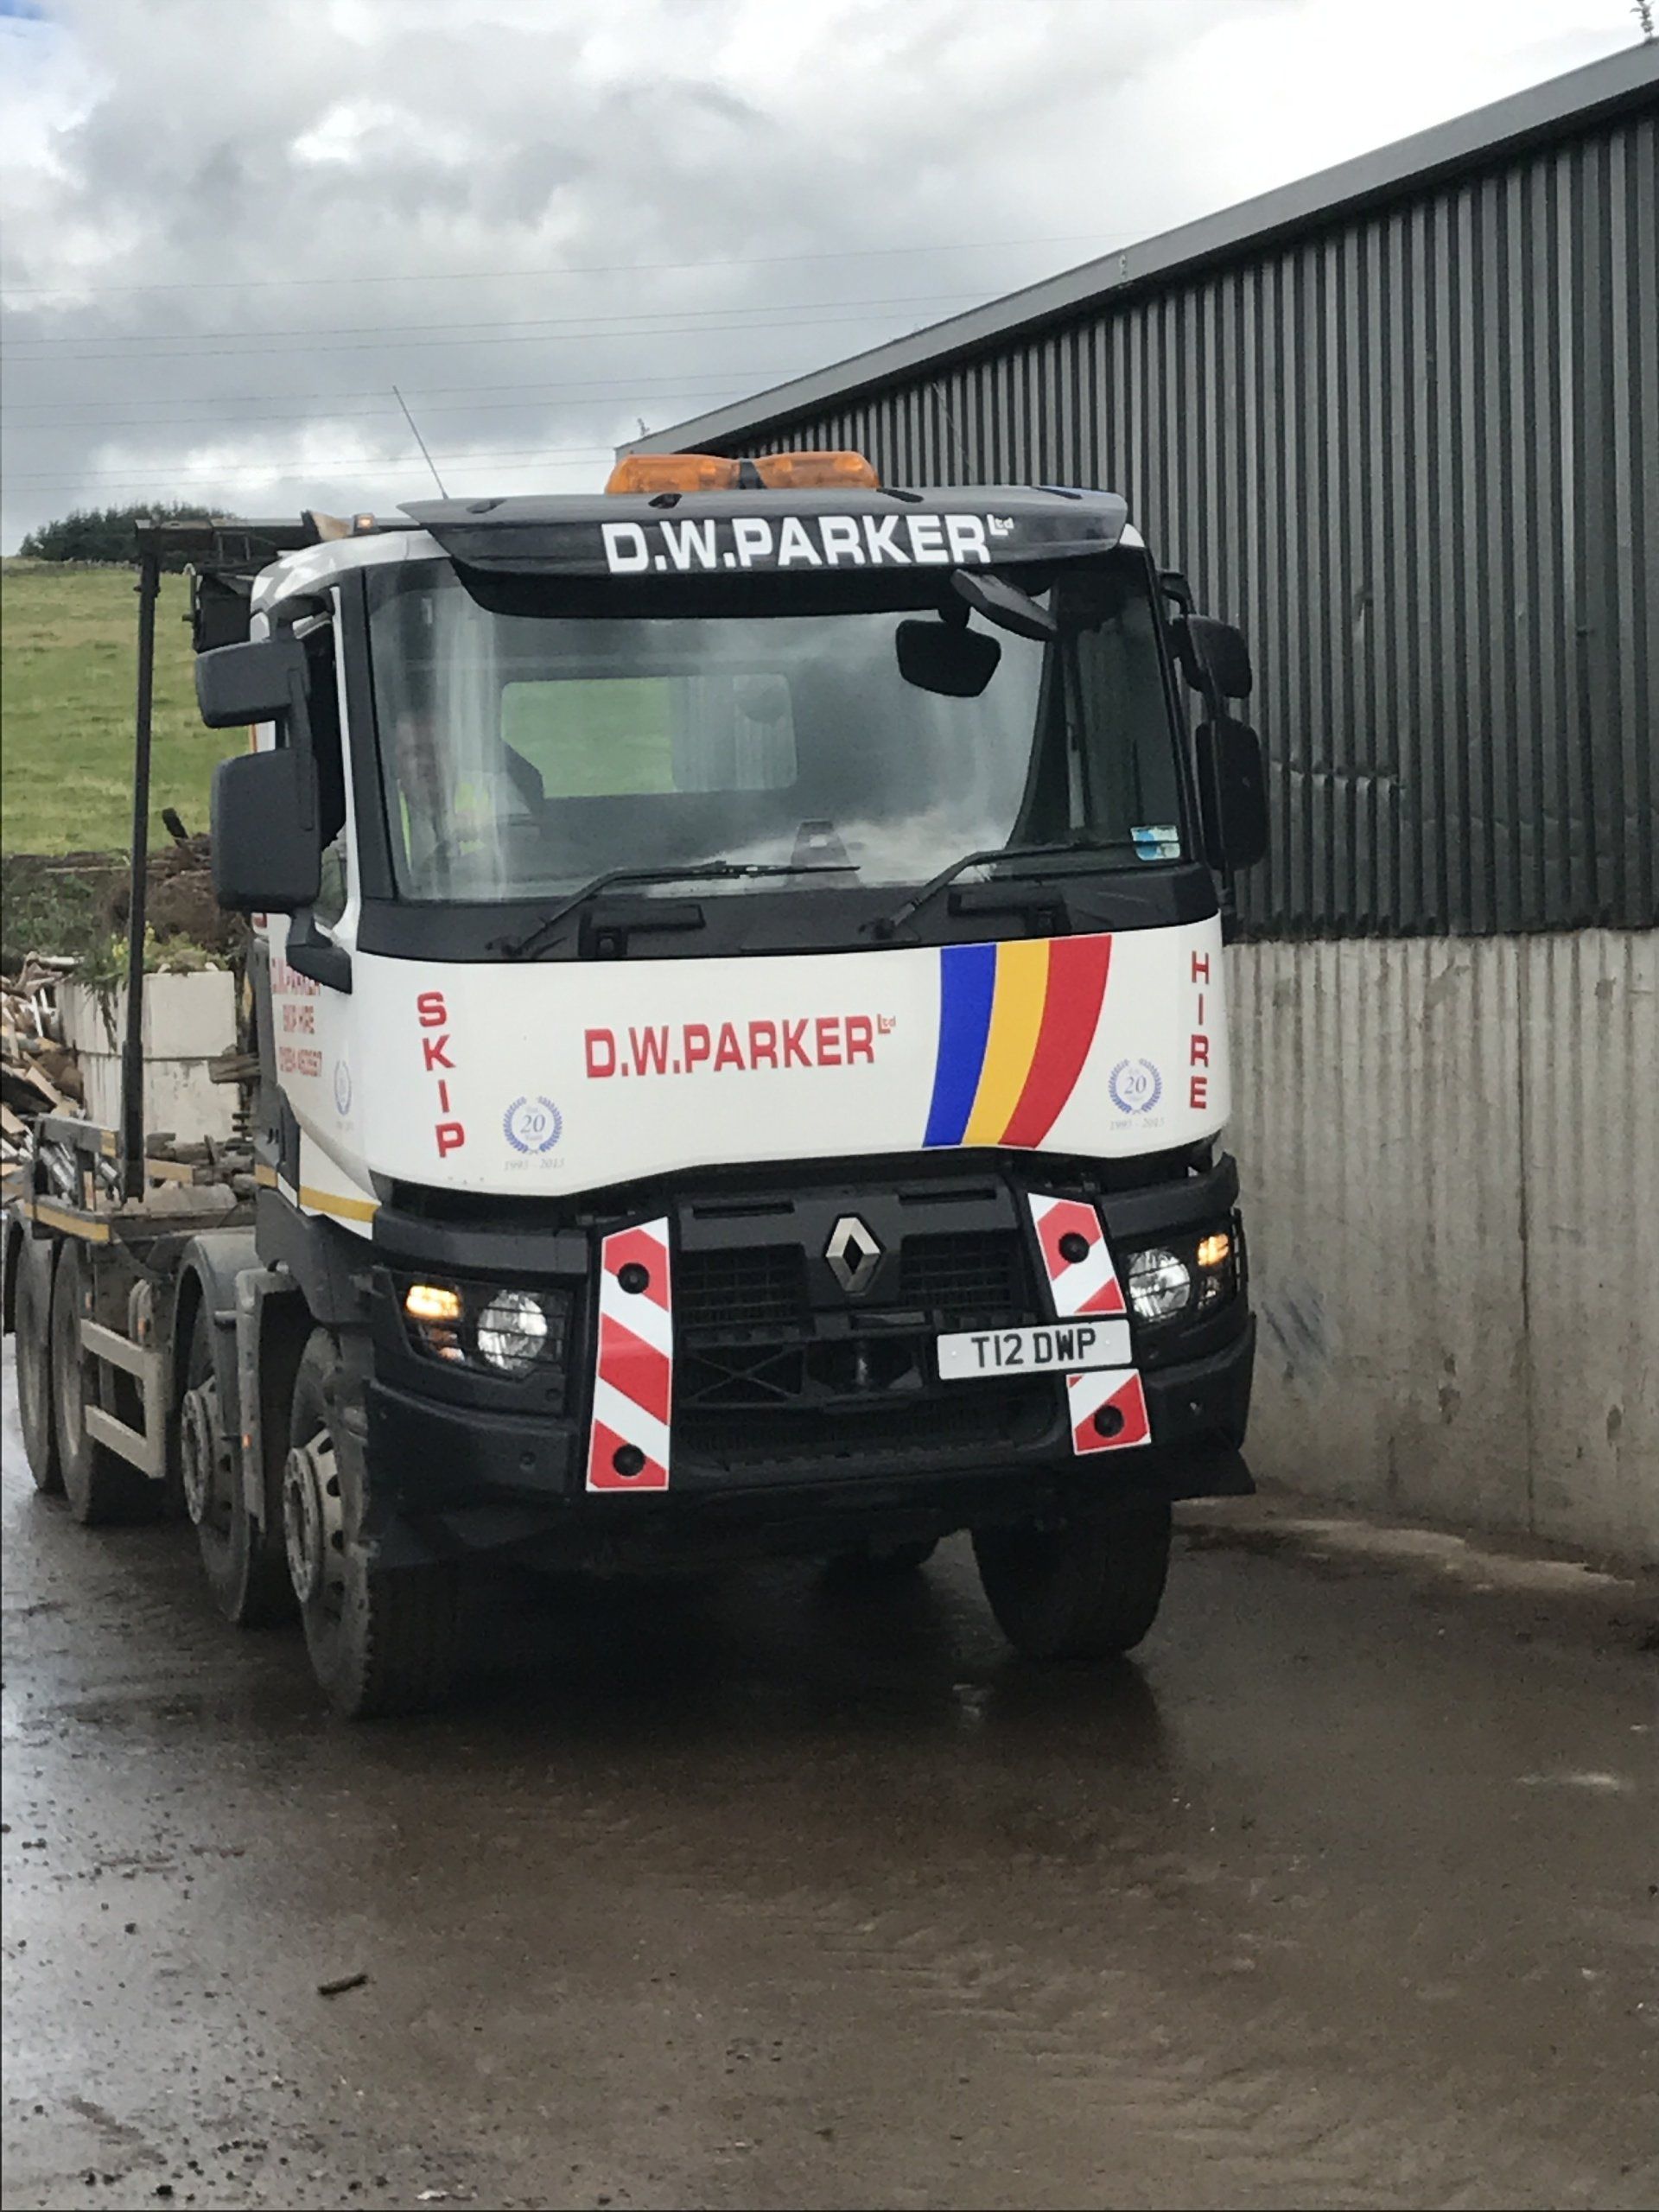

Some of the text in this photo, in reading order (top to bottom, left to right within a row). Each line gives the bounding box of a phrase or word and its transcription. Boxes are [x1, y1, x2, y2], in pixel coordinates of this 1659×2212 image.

[601, 513, 1014, 574] D.W.PARKER Ltd
[584, 1014, 874, 1078] D.W.PARKER
[1190, 950, 1210, 1109] HIRE
[416, 991, 465, 1158] SKIP
[1124, 1075, 1147, 1095] 20
[519, 1114, 546, 1134] 20
[971, 1327, 1096, 1369] T12 DWP
